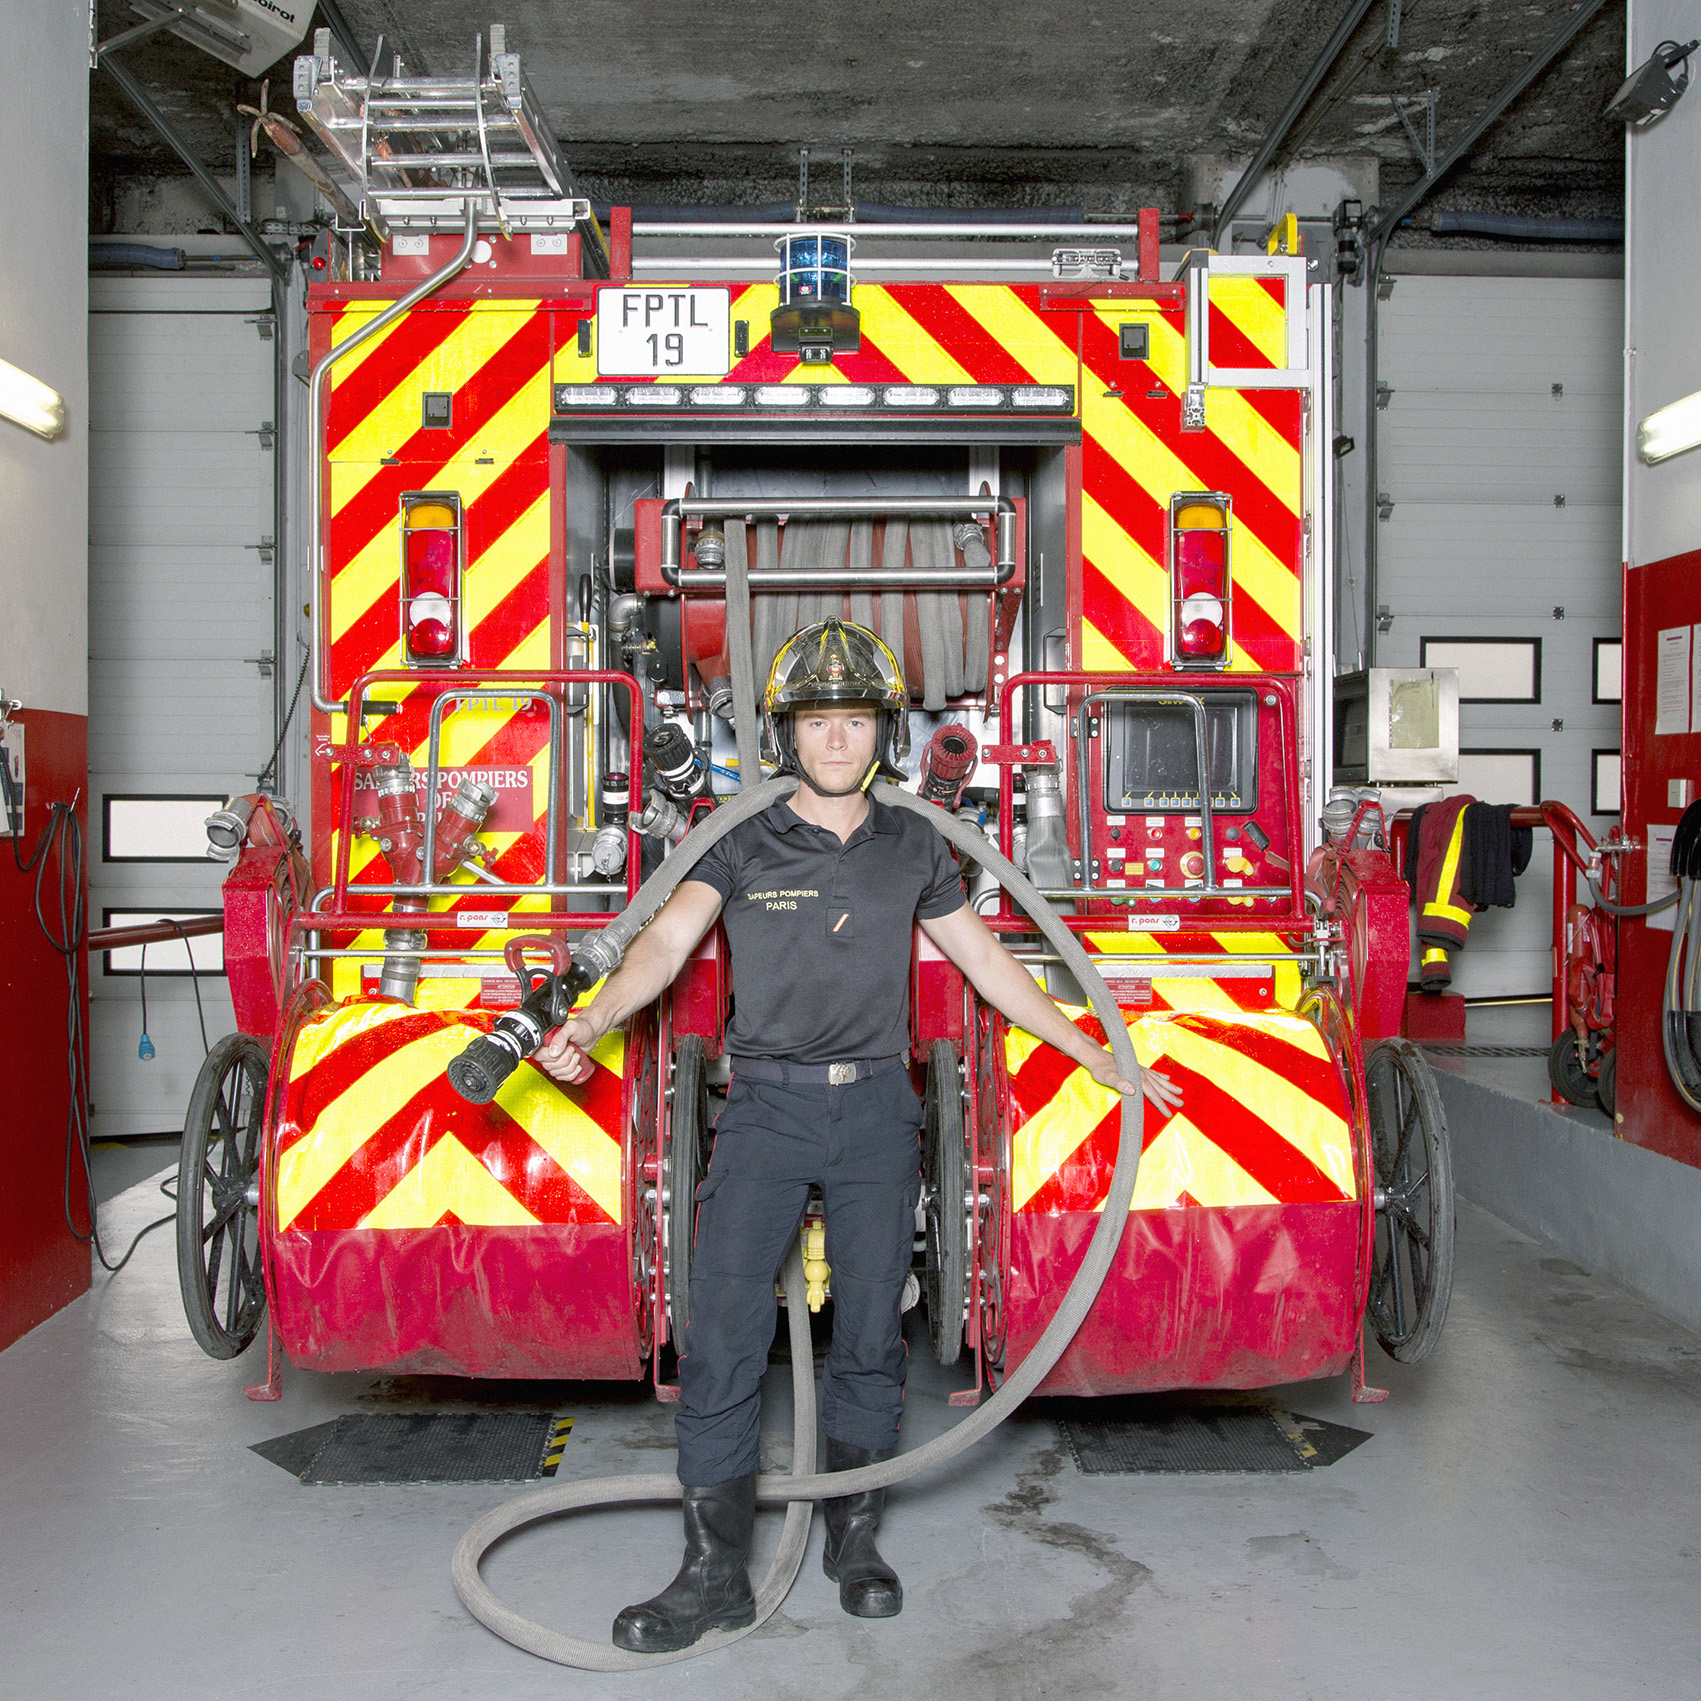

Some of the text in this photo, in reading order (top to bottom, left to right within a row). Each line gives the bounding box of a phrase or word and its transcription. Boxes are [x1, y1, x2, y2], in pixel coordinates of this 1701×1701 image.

[254, 0, 295, 24] oirot
[623, 294, 708, 328] FPTL
[646, 333, 683, 367] 19
[779, 889, 819, 898] POMPIERS
[766, 901, 797, 911] PARIS
